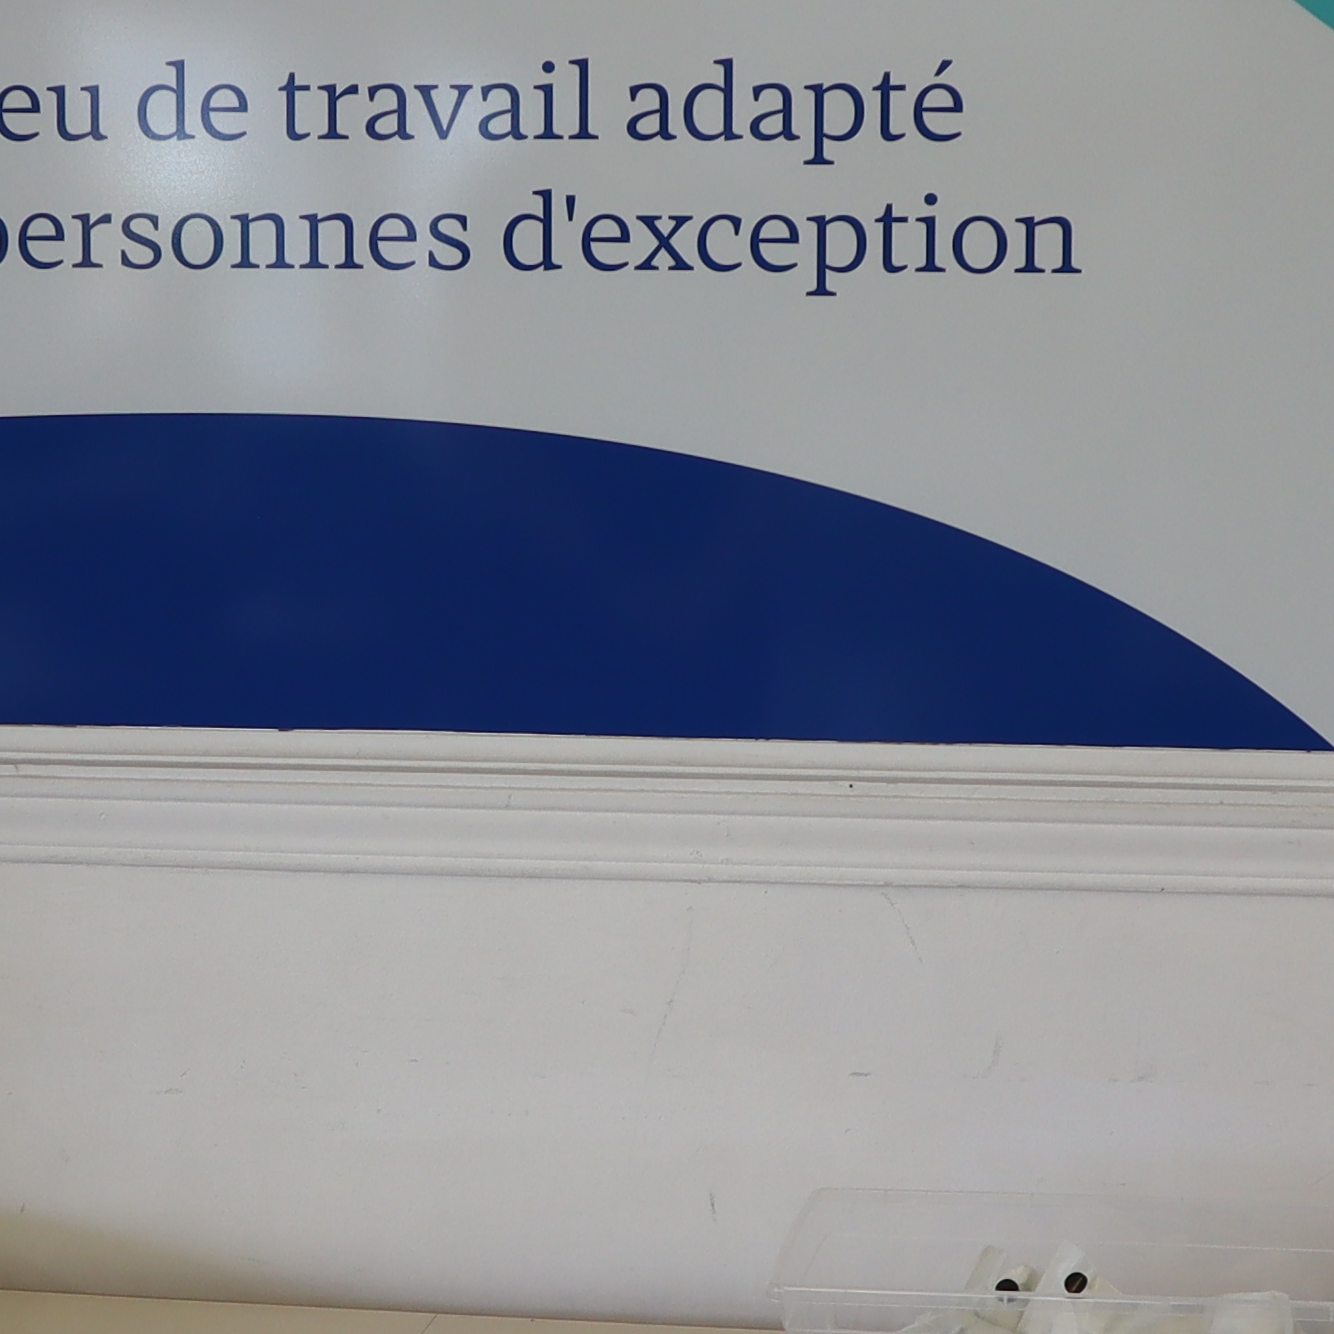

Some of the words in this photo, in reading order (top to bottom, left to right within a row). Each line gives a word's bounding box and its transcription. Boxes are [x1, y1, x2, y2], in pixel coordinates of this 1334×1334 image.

[138, 59, 249, 142] de
[278, 58, 600, 142] travail
[627, 58, 964, 165] adapté
[503, 189, 1083, 297] d'exception
